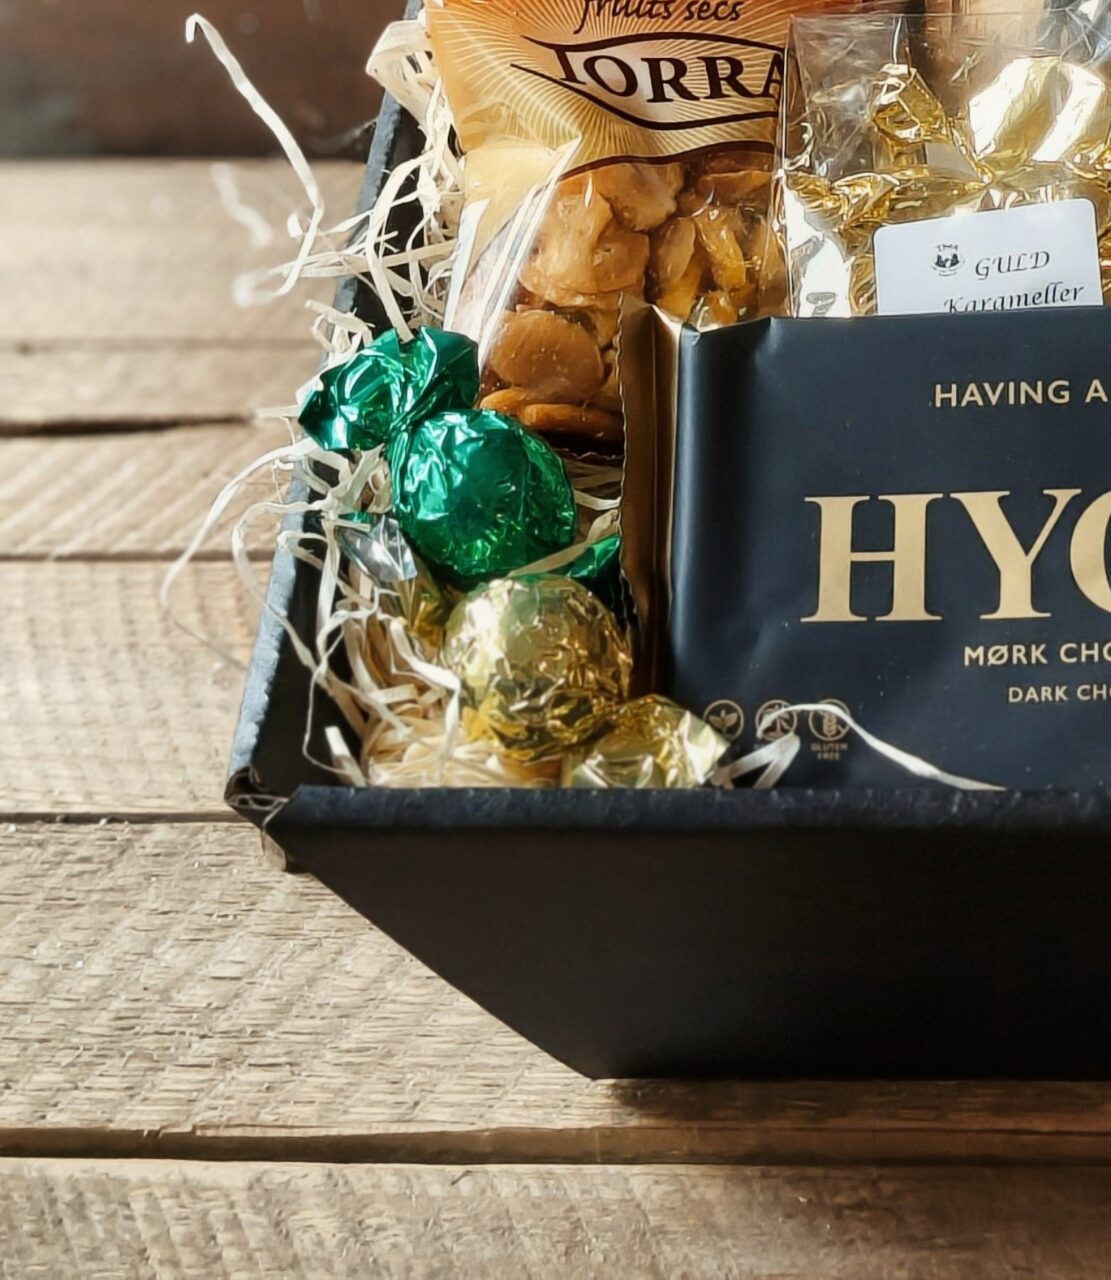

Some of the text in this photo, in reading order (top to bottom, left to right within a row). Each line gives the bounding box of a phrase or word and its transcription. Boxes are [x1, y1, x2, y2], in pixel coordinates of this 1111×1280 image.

[684, 0, 744, 21] secs
[553, 46, 784, 103] TORRA
[974, 250, 1051, 281] GULD
[943, 280, 1085, 313] Karameller
[933, 379, 1071, 408] HAVING
[1085, 378, 1109, 403] A
[963, 642, 1049, 667] MØRK
[1008, 685, 1069, 703] DARK
[810, 742, 849, 751] GLUTEN
[816, 751, 841, 761] FREE
